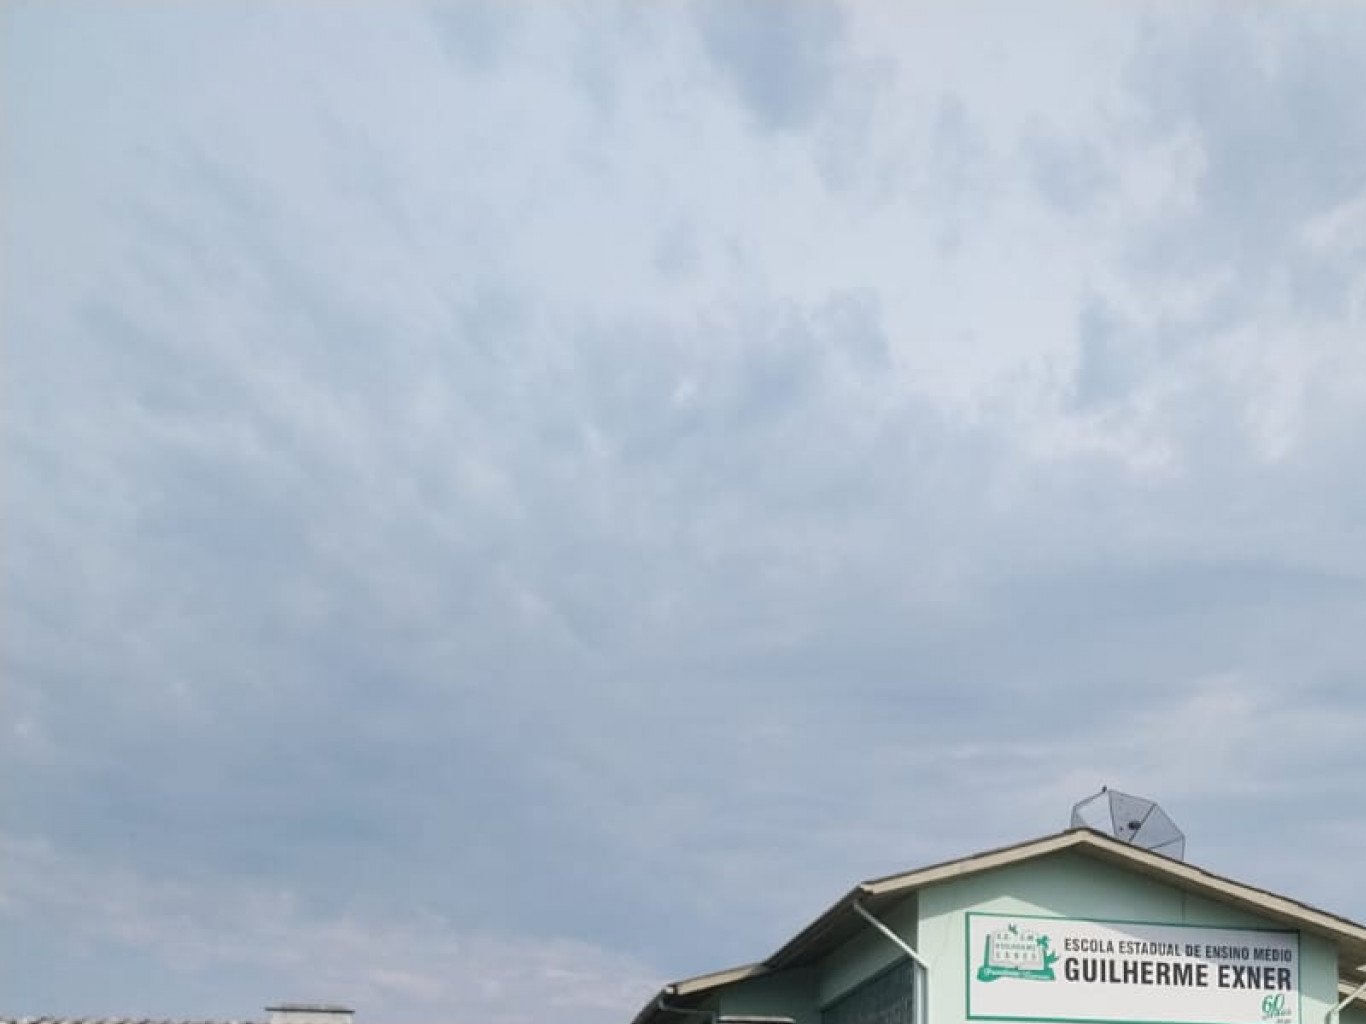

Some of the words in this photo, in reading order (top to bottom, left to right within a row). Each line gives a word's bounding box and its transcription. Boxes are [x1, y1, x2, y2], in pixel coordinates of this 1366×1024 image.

[1064, 938, 1114, 953] ESCOLA
[1119, 940, 1181, 956] ESTADUAL
[1185, 944, 1202, 958] DE
[1205, 945, 1250, 960] ENSINO
[1065, 957, 1209, 988] GUILHERME
[1218, 964, 1292, 990] EXNER
